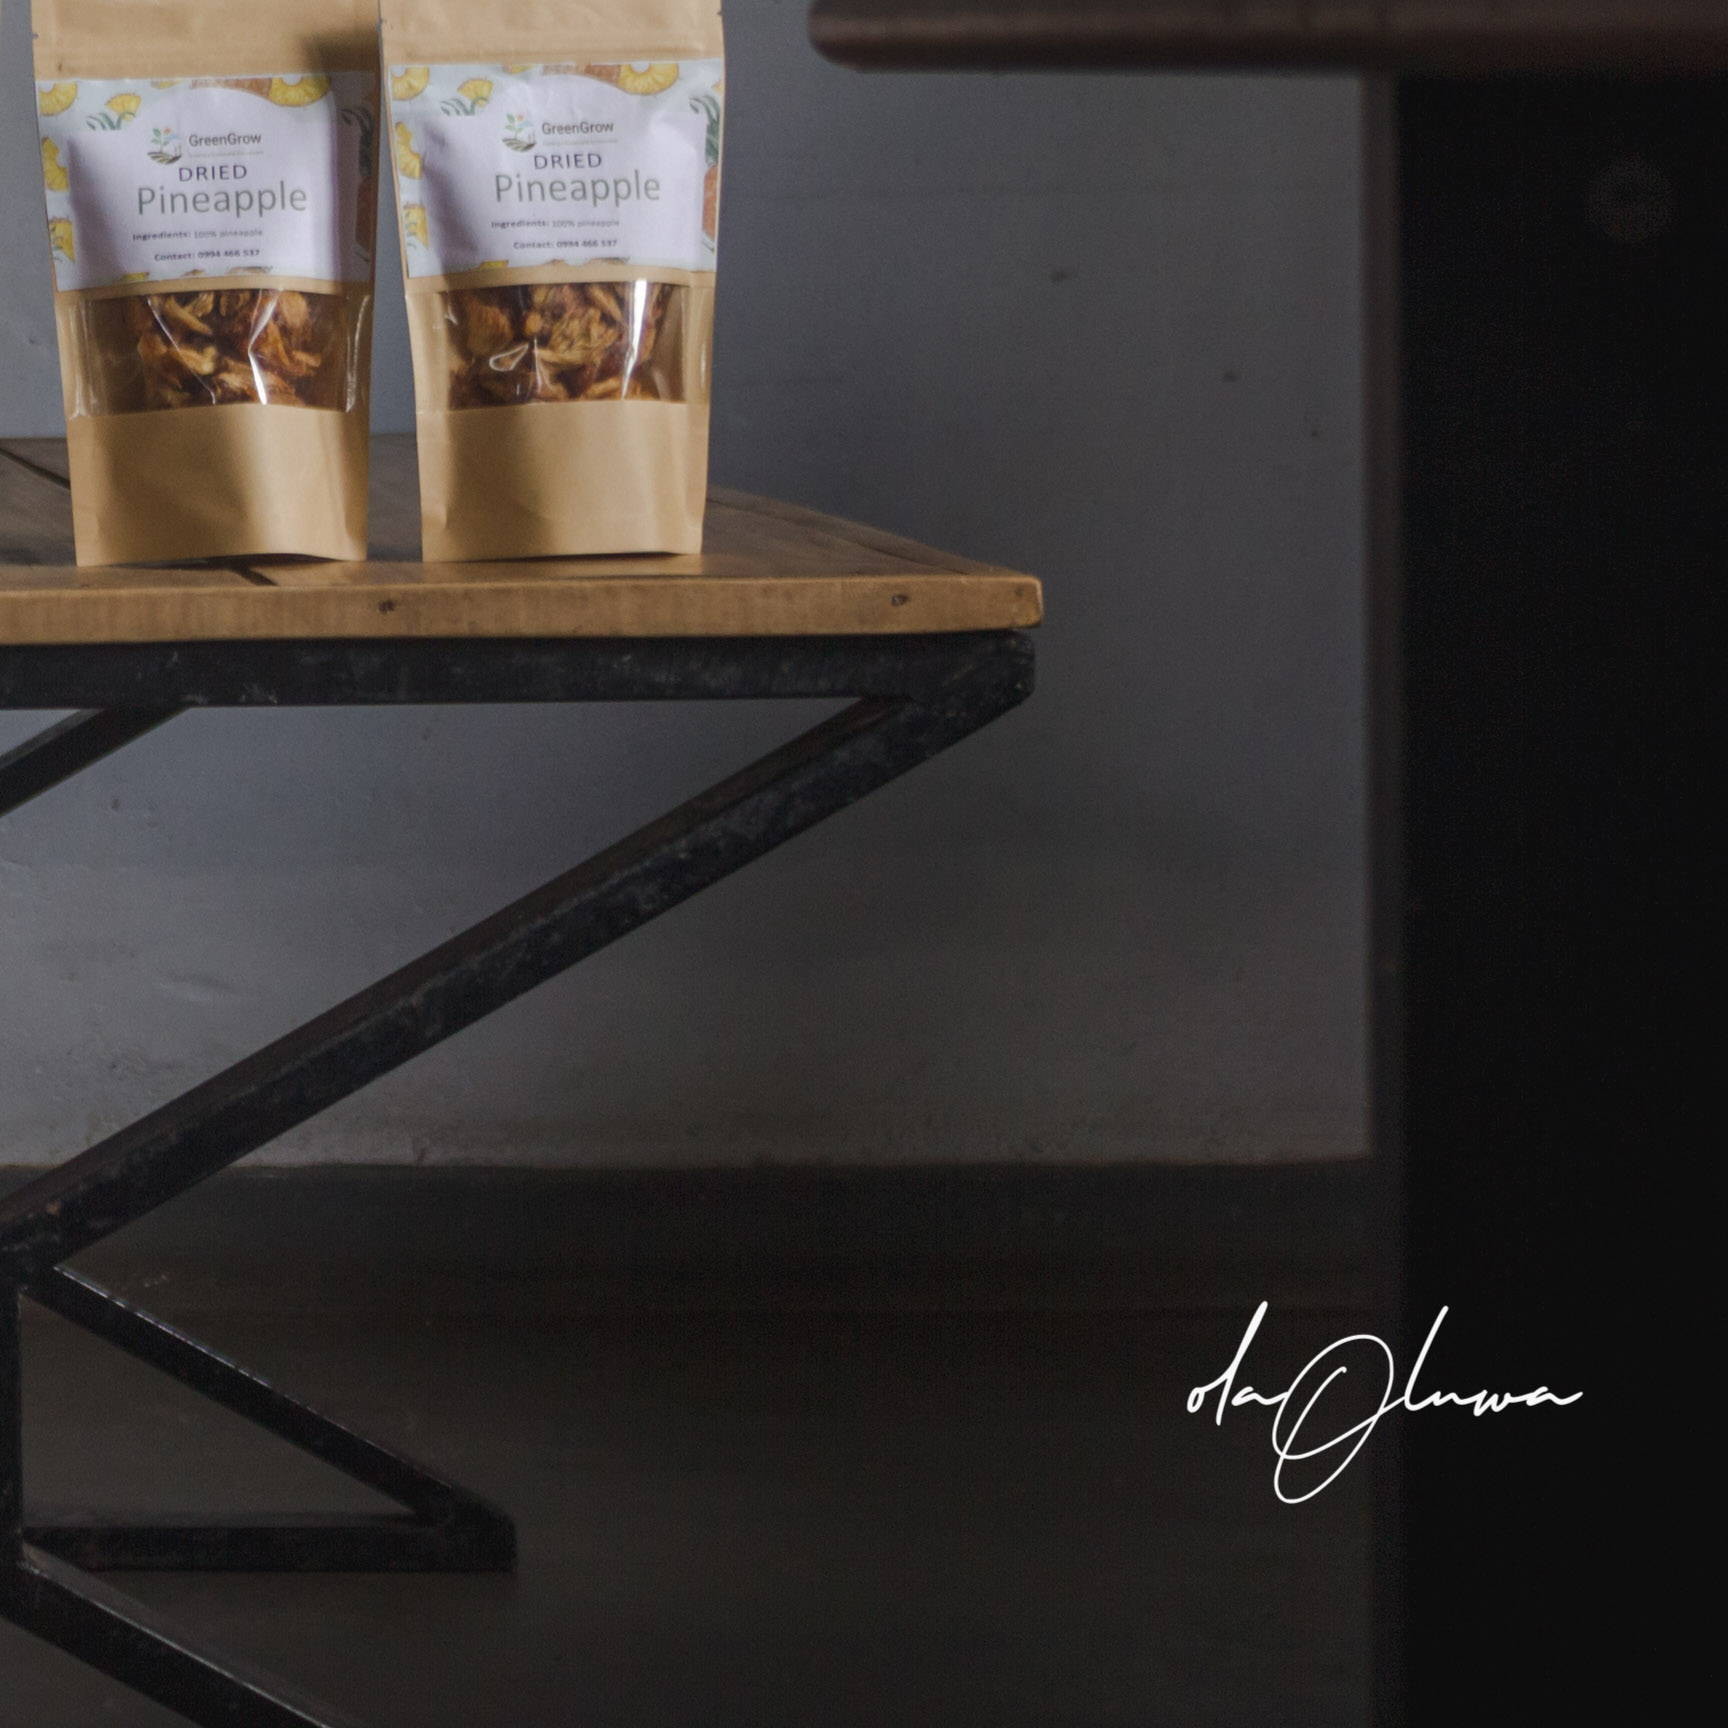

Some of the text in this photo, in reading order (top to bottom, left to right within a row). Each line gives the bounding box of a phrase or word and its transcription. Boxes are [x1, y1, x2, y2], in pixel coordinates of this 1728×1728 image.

[541, 121, 614, 136] GreenGrow
[188, 132, 262, 147] GreenGrow
[533, 152, 602, 170] DRIED
[178, 164, 248, 182] DRIED
[495, 169, 660, 208] Pineapple
[138, 179, 307, 218] Pineapple
[491, 219, 620, 229] Ingredients: 100% pineapple
[132, 229, 263, 242] Ingredients: 100% pineapple
[513, 241, 554, 250] Contact:
[154, 252, 194, 262] Contact:
